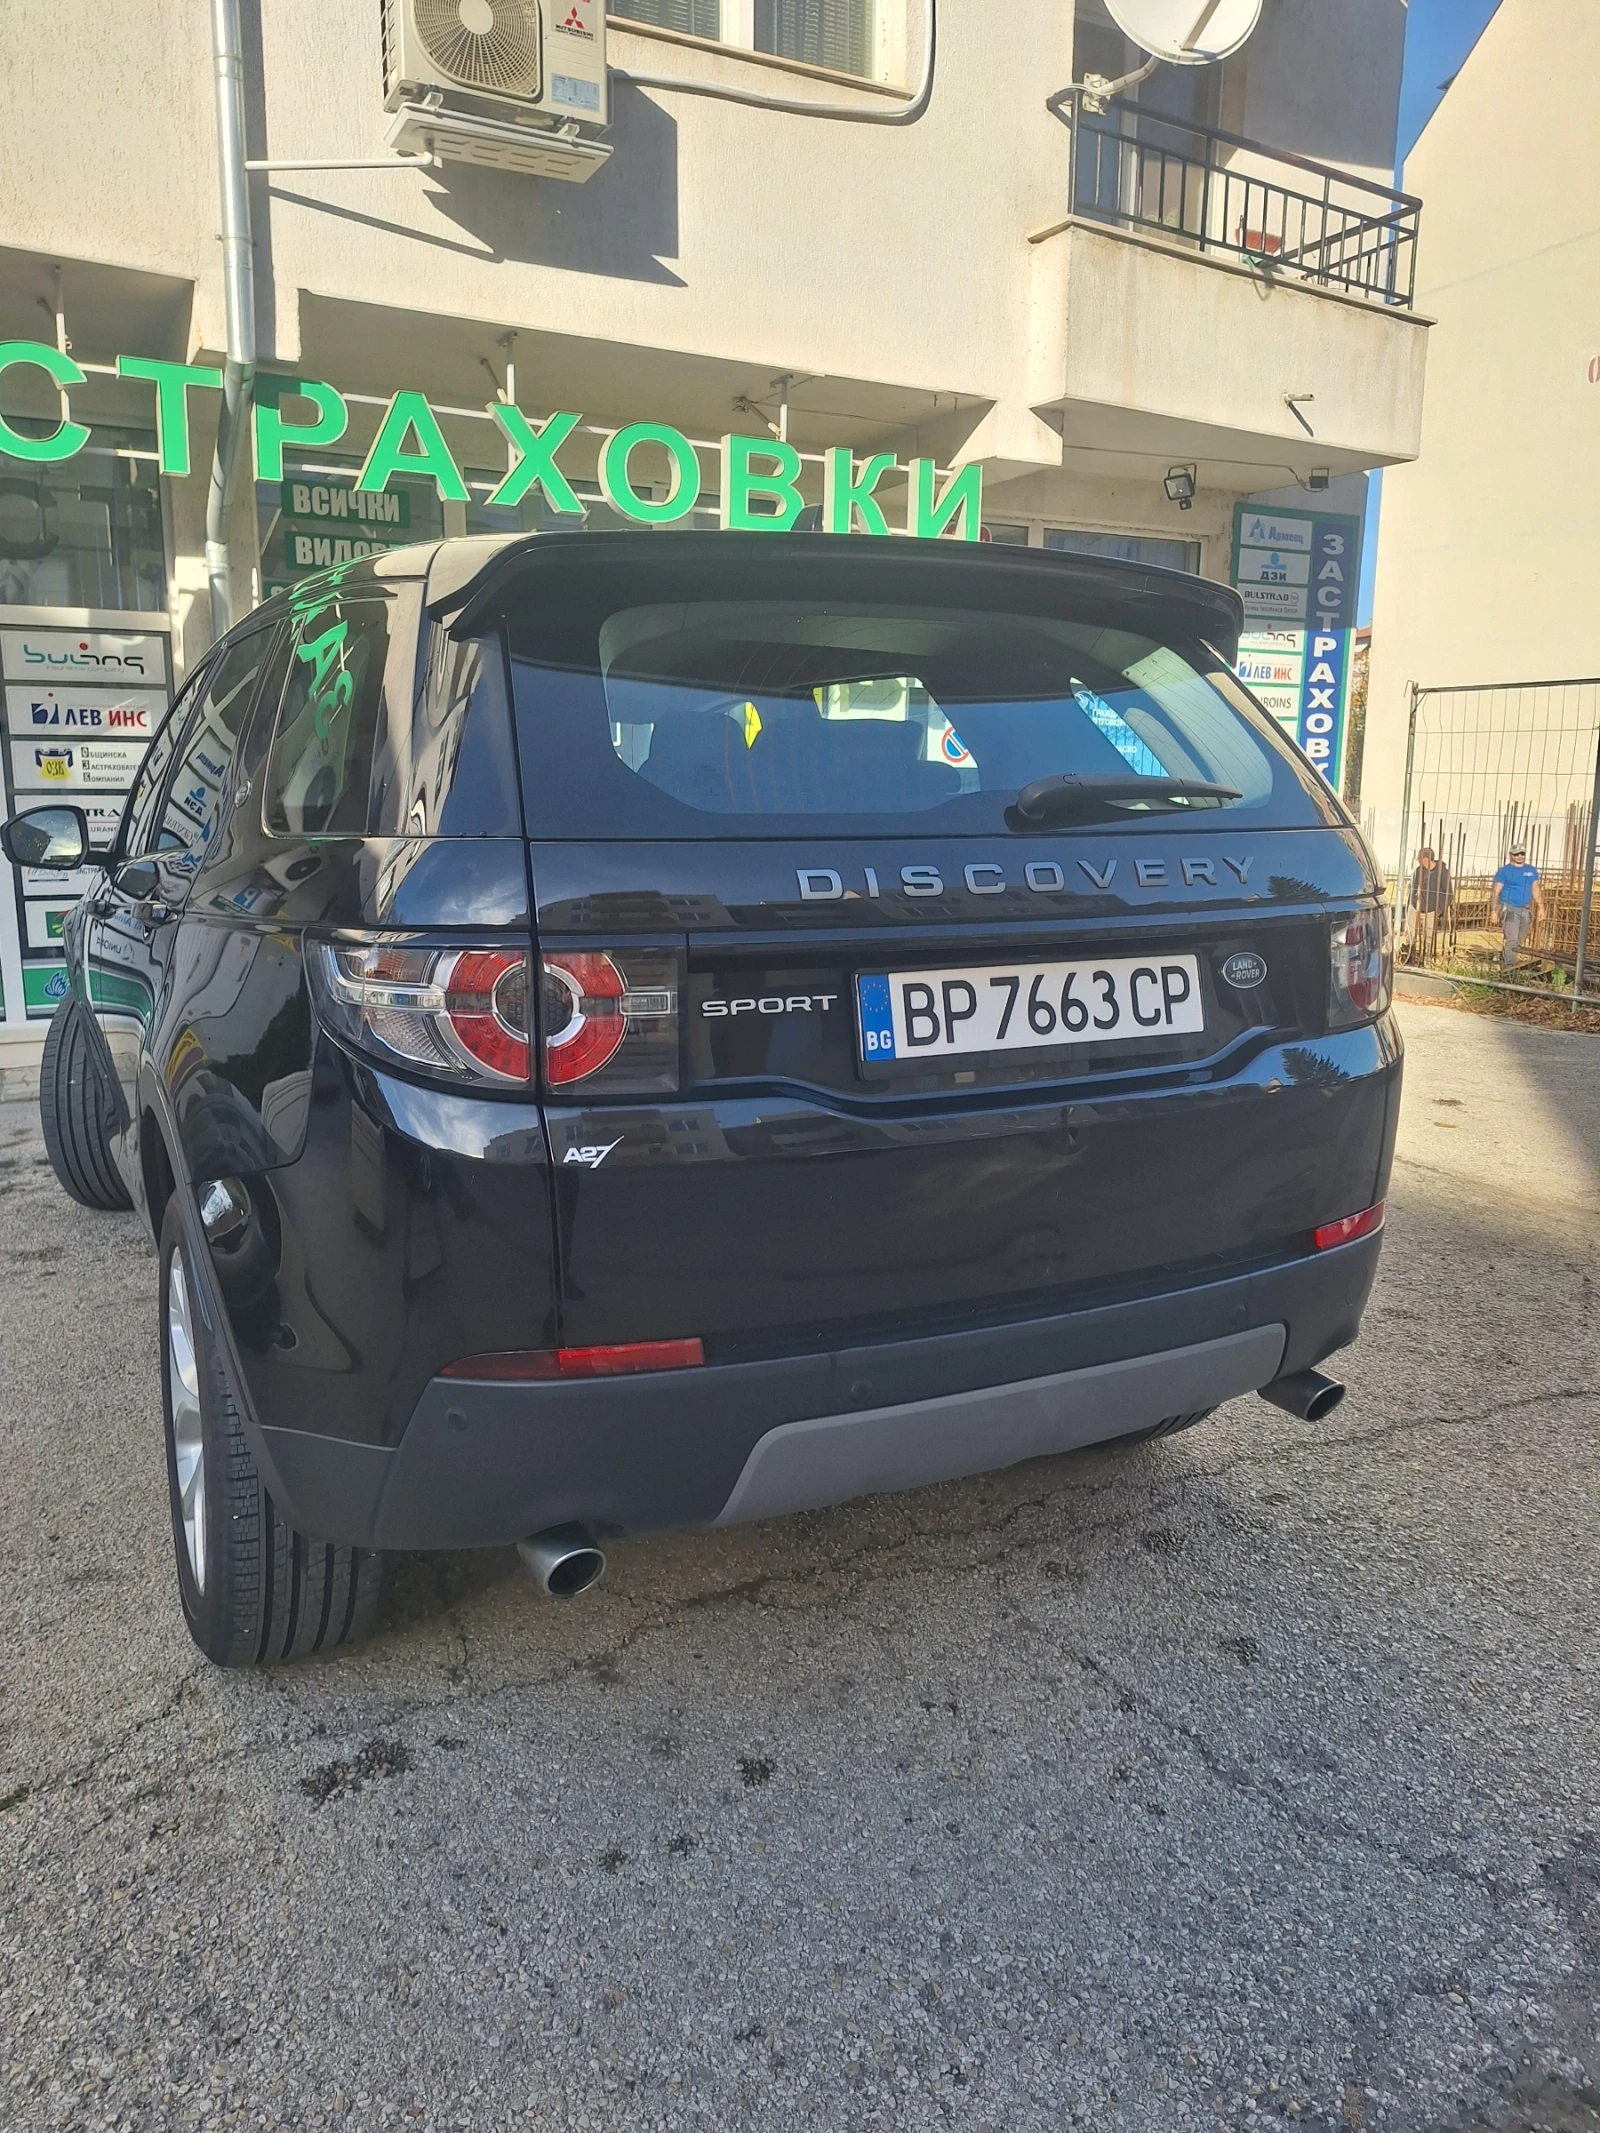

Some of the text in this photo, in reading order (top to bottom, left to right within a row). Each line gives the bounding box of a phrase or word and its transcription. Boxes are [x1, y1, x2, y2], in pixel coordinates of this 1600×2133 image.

[292, 484, 400, 523] ВСИЧКИ
[1268, 526, 1304, 545] Армеец
[1261, 571, 1287, 581] ДЗИ
[1244, 590, 1289, 601] BULSTRAD
[1303, 533, 1346, 780] ЗАСТРАХОВ
[1253, 666, 1292, 680] ЛЕВ ИНС
[65, 709, 147, 727] ЛЕВ ИНС
[81, 747, 127, 758] ОБЩИНСКА
[46, 759, 65, 776] ОЗК
[83, 772, 125, 782] КОМПАНИЯ
[796, 856, 1255, 900] DISCOVERY
[1233, 960, 1253, 971] LAND
[1236, 969, 1260, 980] ROVER
[702, 995, 838, 1017] SPORT
[902, 965, 1190, 1047] BP 7663 CP
[866, 1031, 892, 1051] BG
[562, 1135, 625, 1169] A27
